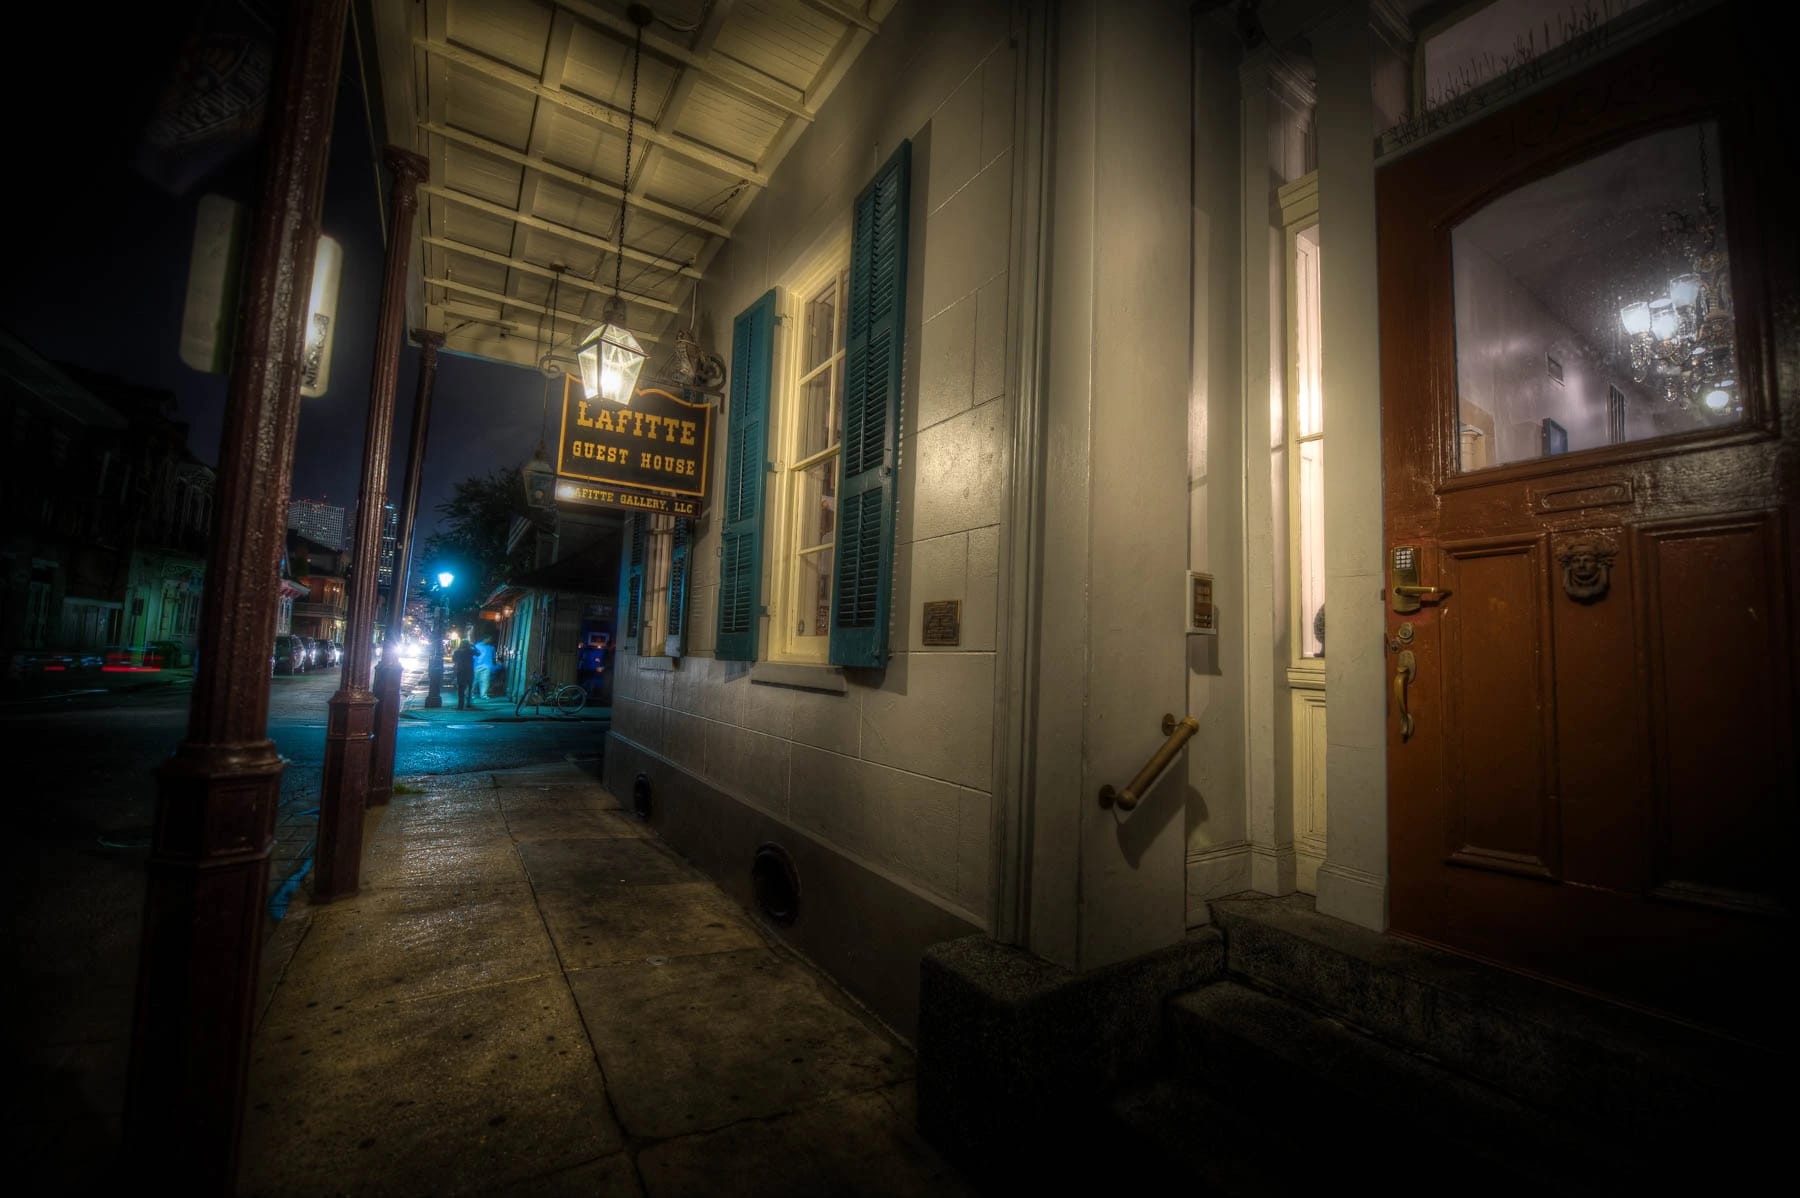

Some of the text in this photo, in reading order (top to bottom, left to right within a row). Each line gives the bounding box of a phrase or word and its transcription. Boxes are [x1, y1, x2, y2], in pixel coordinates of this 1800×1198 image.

[577, 401, 696, 446] LAFITTE
[572, 440, 696, 476] GUEST HOUSE
[568, 485, 614, 503] AFITTE
[674, 502, 693, 514] LLC
